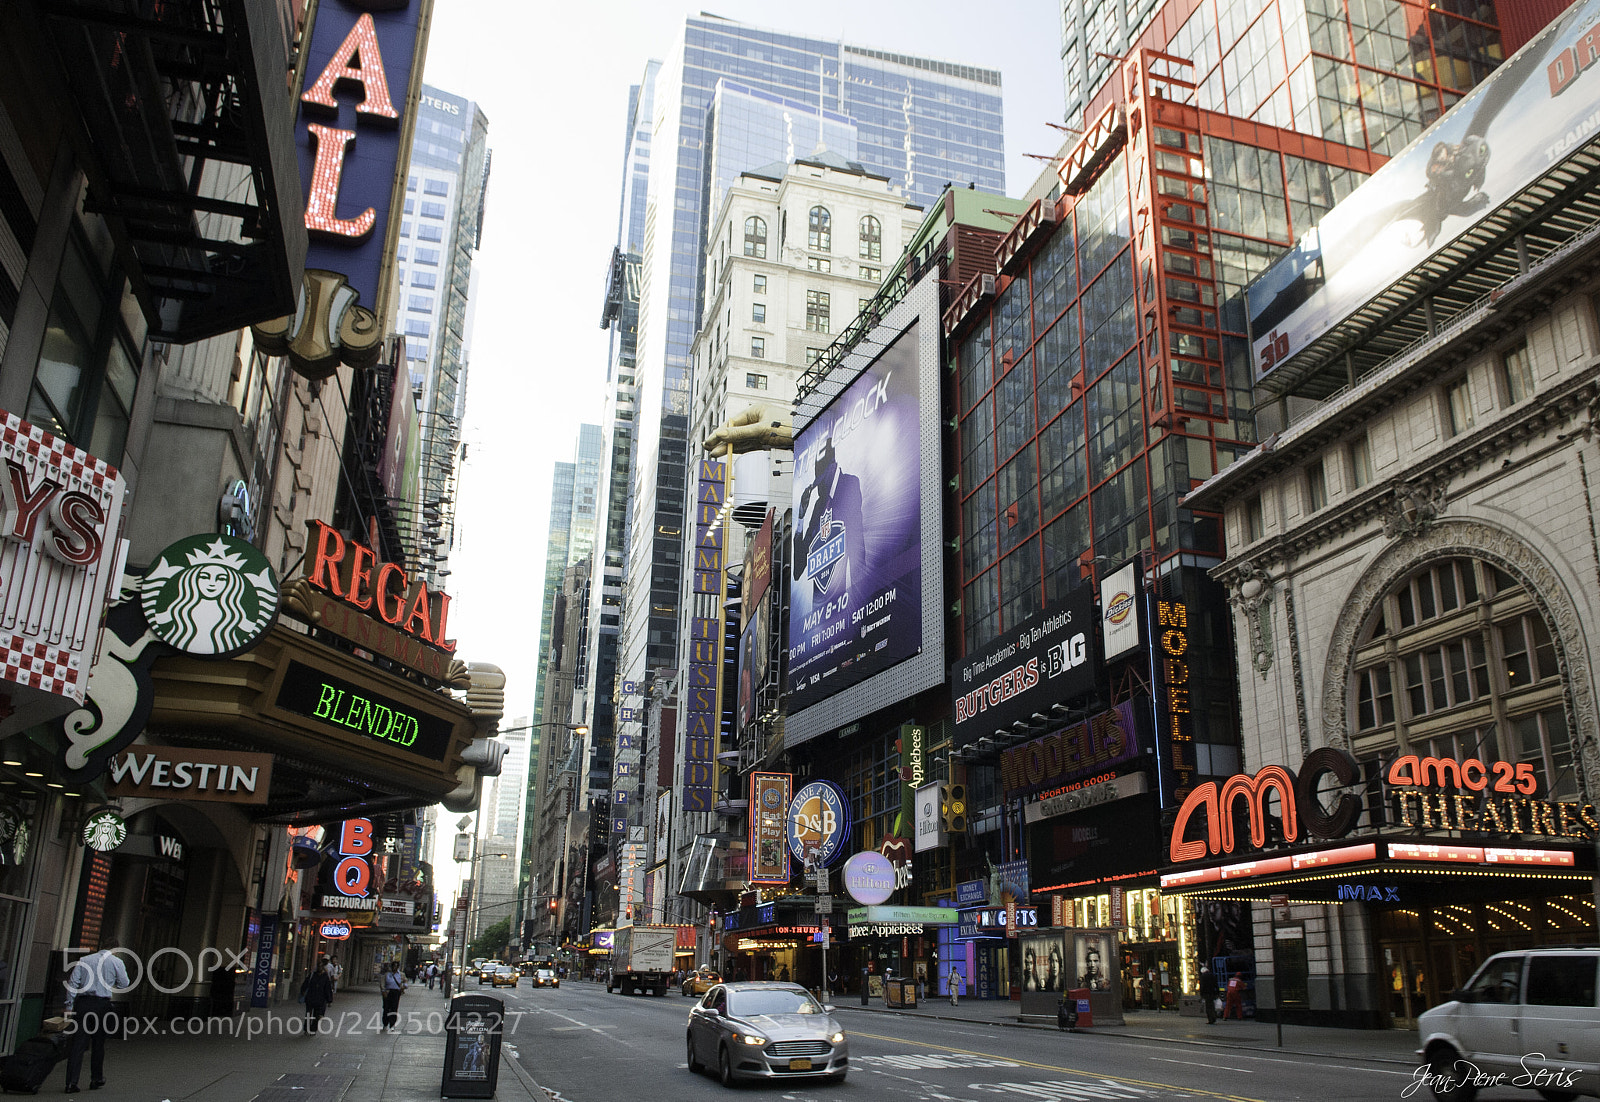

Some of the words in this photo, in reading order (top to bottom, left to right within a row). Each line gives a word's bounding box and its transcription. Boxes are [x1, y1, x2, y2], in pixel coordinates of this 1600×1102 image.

[1269, 332, 1278, 341] IN
[1260, 334, 1290, 372] 3D
[798, 430, 829, 478] THE
[831, 370, 893, 448] CLOCK
[701, 461, 723, 592] MADAME
[809, 537, 843, 573] DRAFT
[307, 520, 457, 652] REGAL
[803, 606, 825, 633] MAY
[825, 592, 849, 620] 8-10
[852, 606, 865, 624] SAT
[866, 595, 884, 616] 12:00
[885, 588, 896, 605] PM
[1106, 599, 1132, 616] Dickies
[321, 602, 440, 676] CINEMAS
[811, 631, 821, 647] FRI
[821, 624, 835, 642] 7:00
[835, 618, 846, 635] PM
[963, 665, 972, 682] Big
[972, 659, 985, 678] Time
[985, 642, 1016, 671] Academics
[1019, 632, 1030, 649] Big
[1030, 626, 1042, 644] Ten
[1042, 610, 1072, 636] Athletics
[810, 673, 820, 685] VISA
[955, 657, 1039, 724] RUTGERS
[1040, 662, 1047, 674] is
[1048, 632, 1087, 678] BIG
[313, 683, 419, 747] BLENDED
[111, 752, 259, 793] WESTIN
[616, 682, 632, 831] CHAMPS
[908, 728, 922, 789] Applebee's
[1040, 783, 1081, 801] SPORTING
[1083, 771, 1117, 788] GOODS
[1494, 760, 1537, 795] 25
[793, 787, 815, 810] DAVE
[817, 785, 836, 805] AND
[761, 812, 781, 820] Eat
[793, 810, 837, 838] D&B
[919, 819, 938, 837] Hilton
[1392, 789, 1600, 839] THEATRES
[761, 827, 781, 837] Play
[851, 876, 890, 890] Hilton
[1338, 884, 1399, 902] IMAX
[322, 895, 379, 910] RESTAURANT
[998, 910, 1037, 926] GFTS
[262, 923, 274, 950] TIER
[259, 952, 271, 977] BOX
[980, 947, 988, 998] CHANGE
[256, 978, 267, 998] 245
